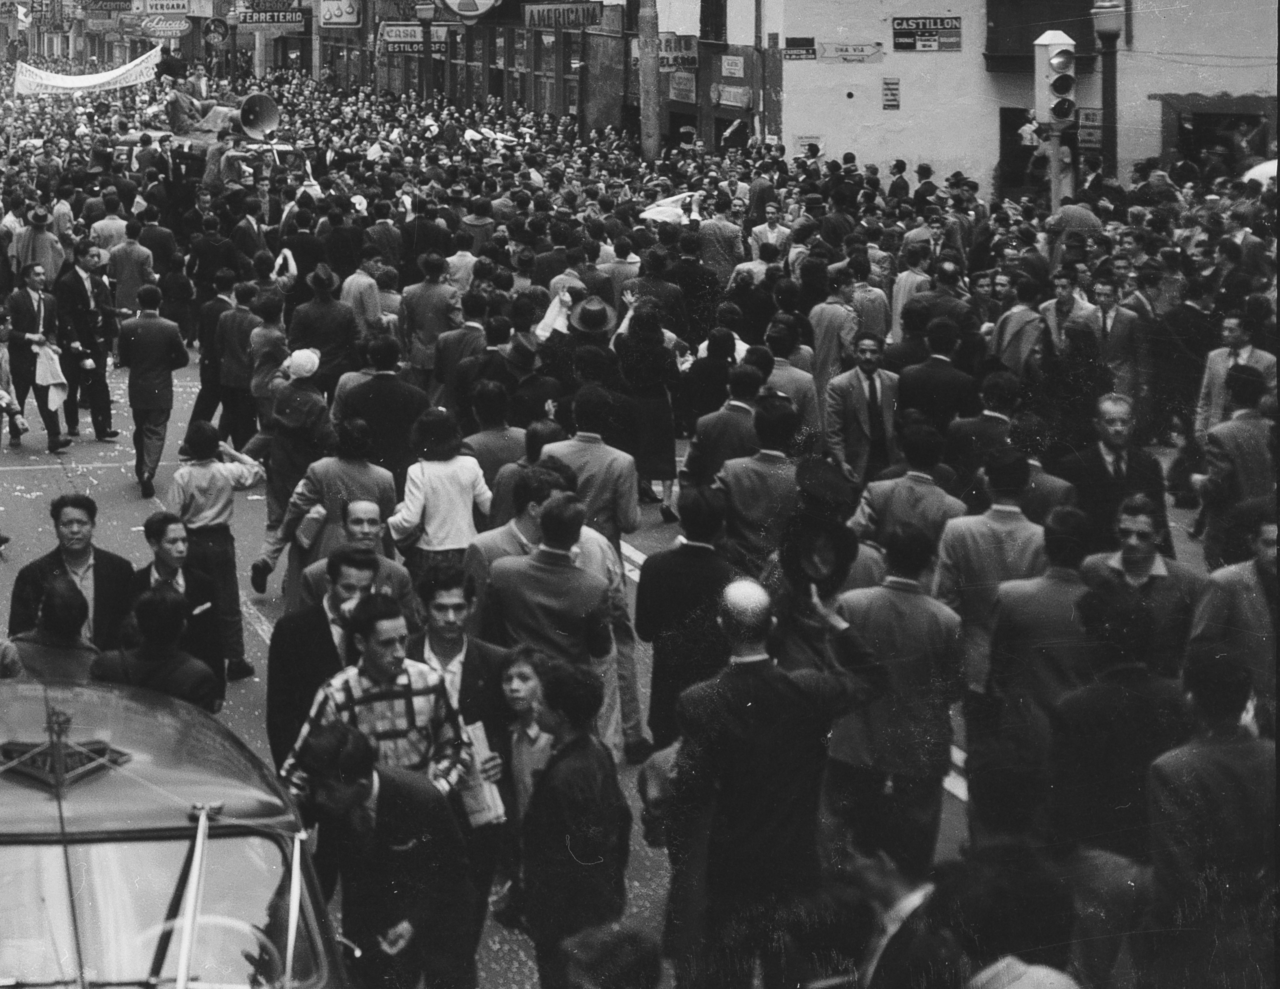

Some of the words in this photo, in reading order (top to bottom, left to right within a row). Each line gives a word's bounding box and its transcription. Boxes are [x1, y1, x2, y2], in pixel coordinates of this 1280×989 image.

[240, 12, 303, 23] FERRETERIA
[529, 5, 600, 28] AMERICANA
[146, 15, 189, 30] Lucas
[893, 19, 960, 29] CASTILLON
[387, 29, 417, 39] CASA
[388, 43, 446, 51] ESTILOGAFO
